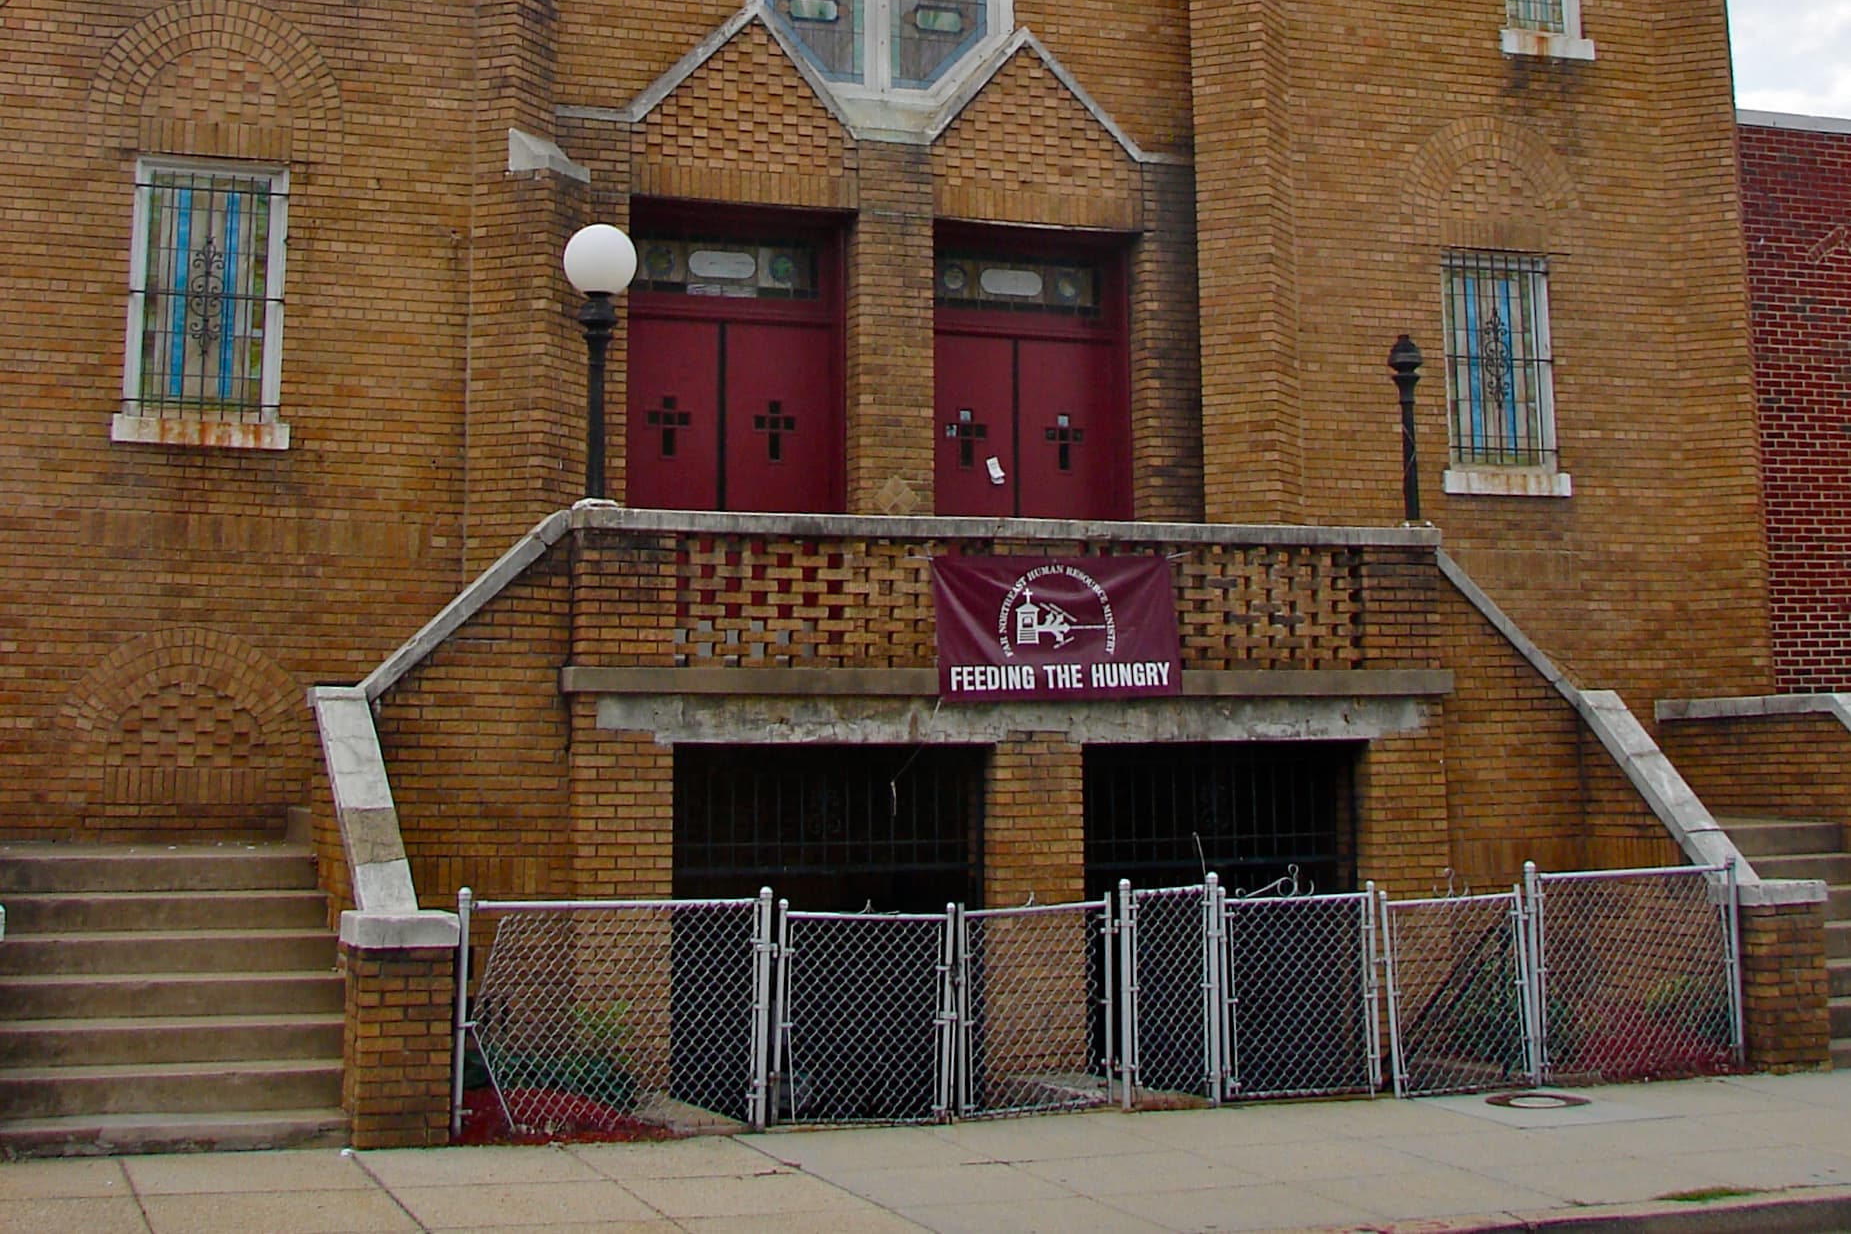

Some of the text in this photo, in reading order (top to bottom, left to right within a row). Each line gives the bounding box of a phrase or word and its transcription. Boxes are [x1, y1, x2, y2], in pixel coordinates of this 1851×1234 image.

[998, 565, 1116, 658] FAR NORTHEAST HUMAN RESOURCE MINISTRY
[951, 661, 1170, 691] FEEDING THE HUNGRY
